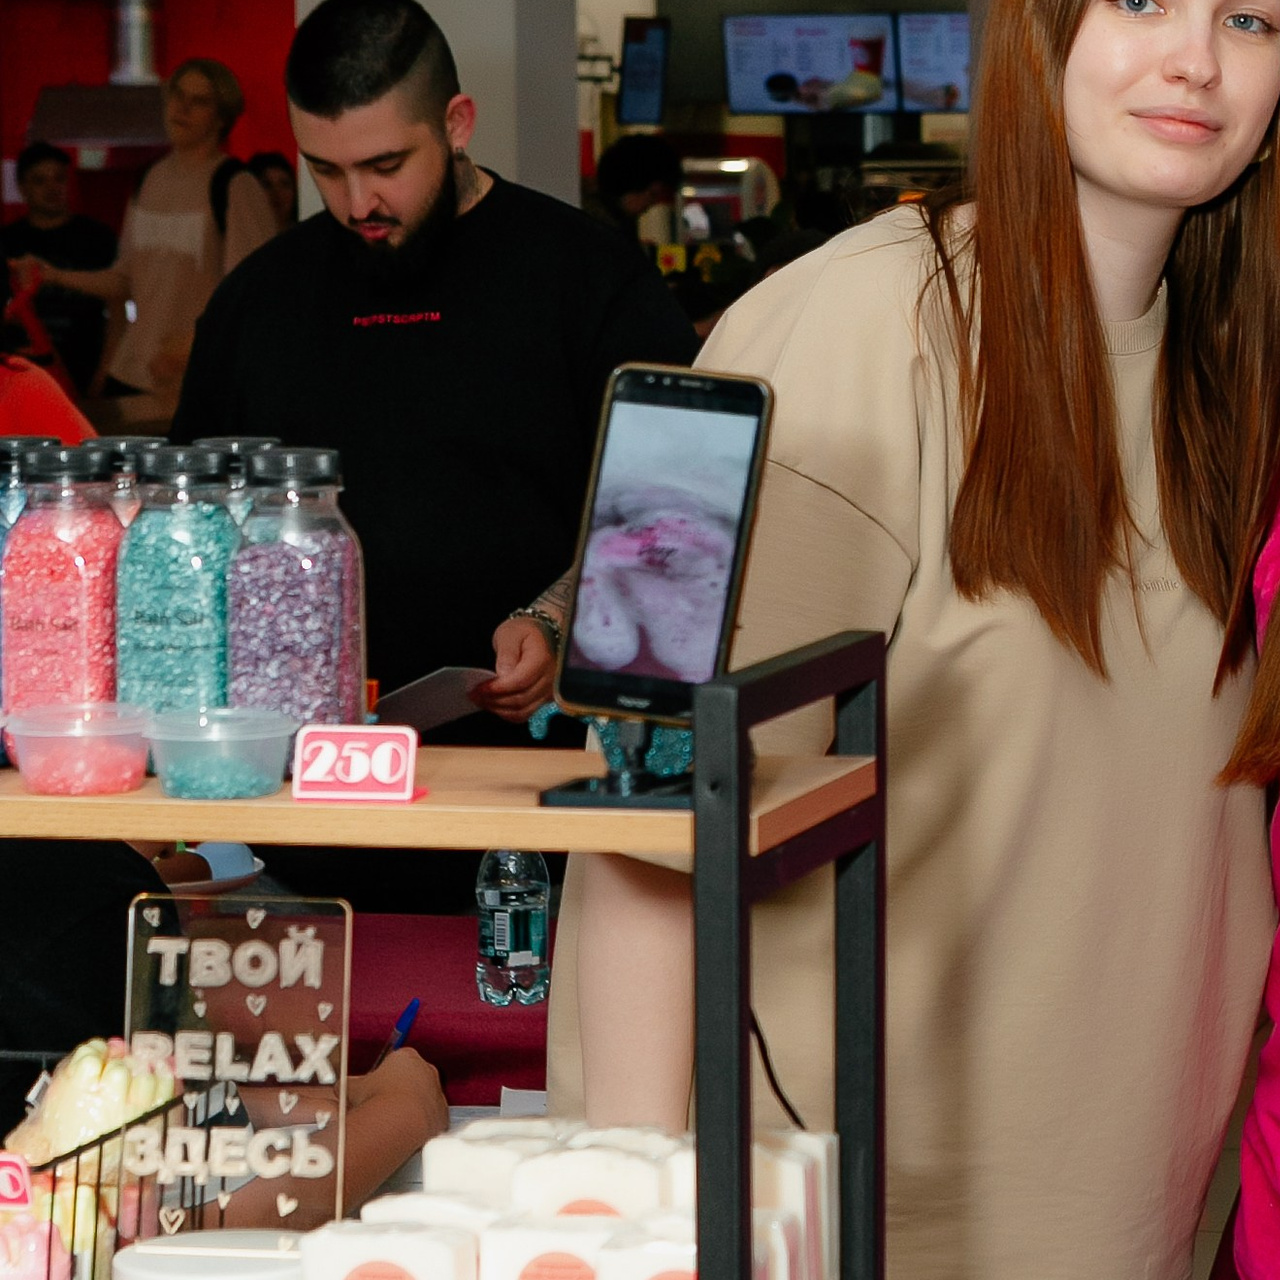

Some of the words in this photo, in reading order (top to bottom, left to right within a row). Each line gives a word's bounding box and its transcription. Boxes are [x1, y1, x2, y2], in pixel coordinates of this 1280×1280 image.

[302, 739, 408, 785] 250
[146, 925, 325, 990] ТВОЙ
[131, 1030, 341, 1085] RELAX
[124, 1126, 335, 1186] ЗДЕСЬ
